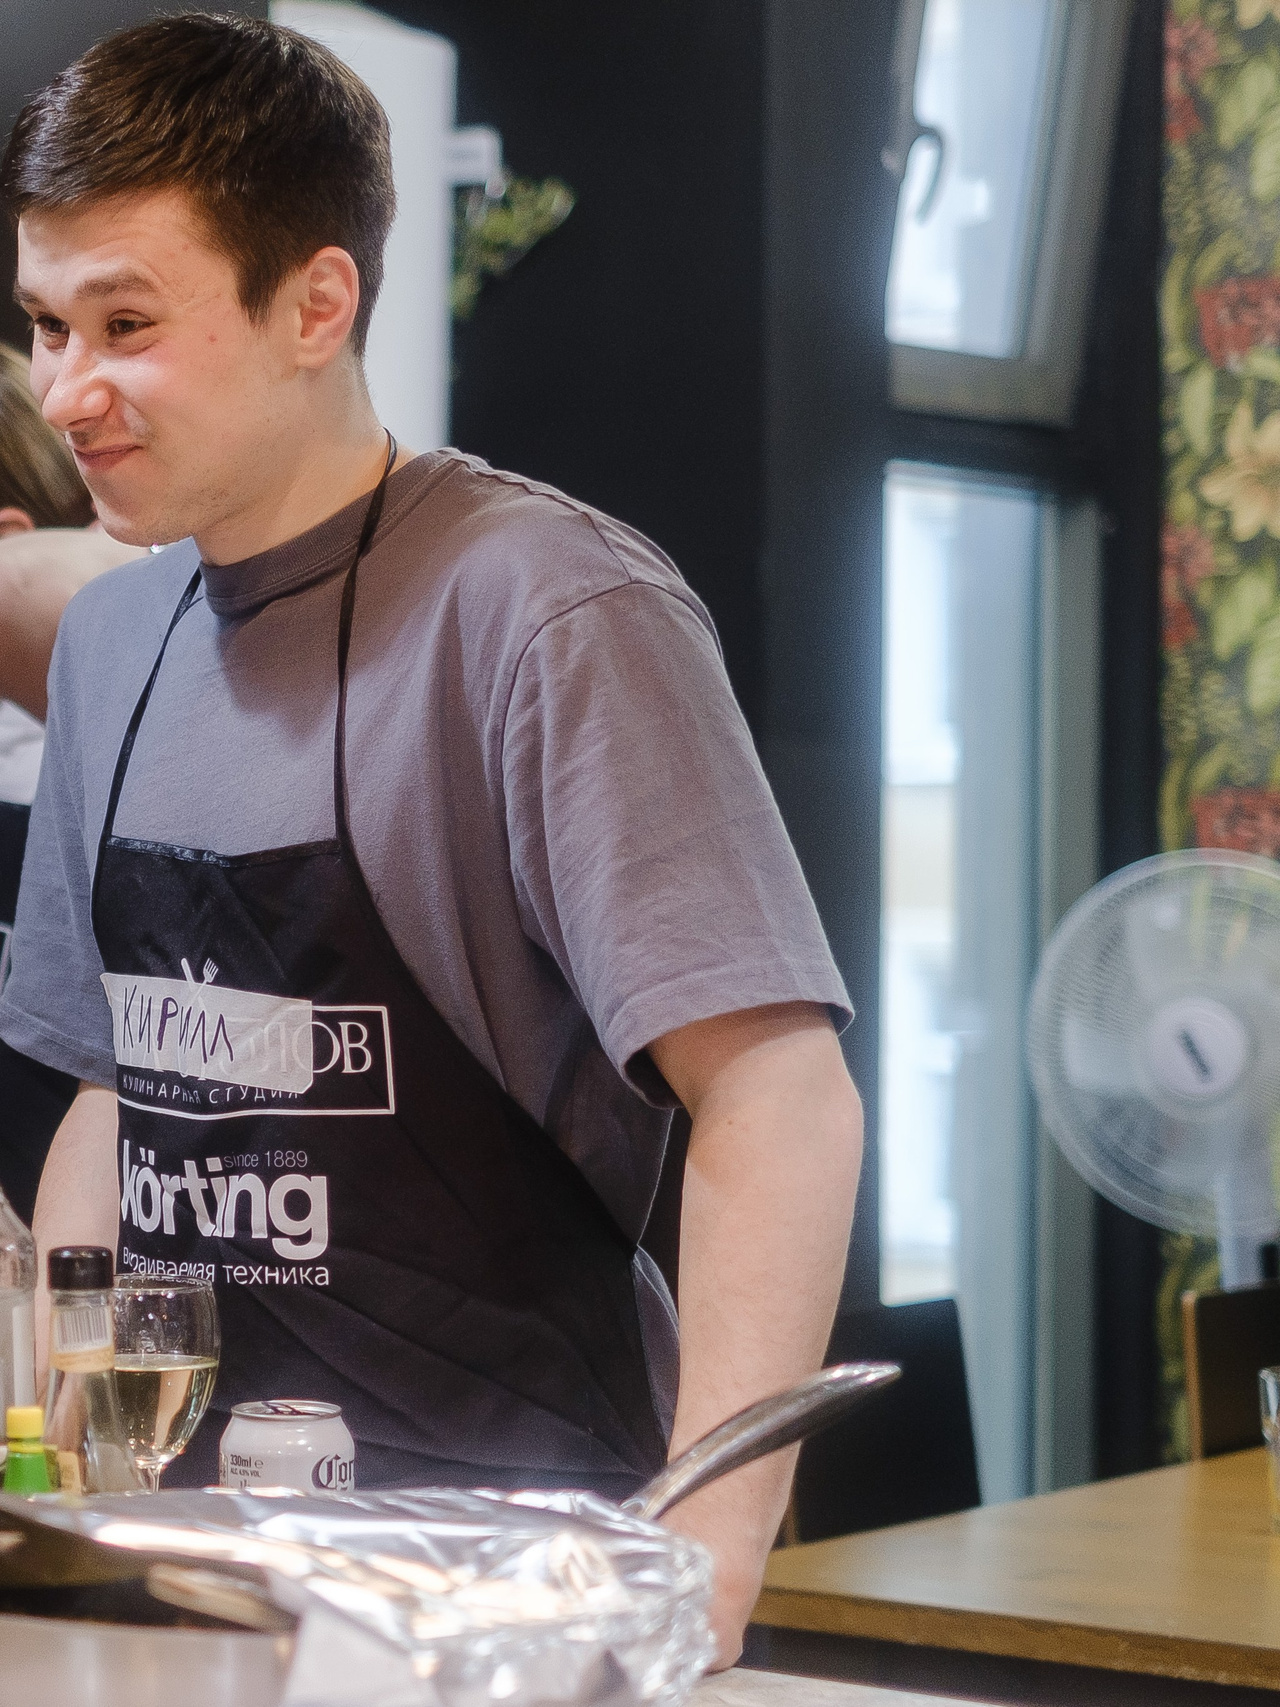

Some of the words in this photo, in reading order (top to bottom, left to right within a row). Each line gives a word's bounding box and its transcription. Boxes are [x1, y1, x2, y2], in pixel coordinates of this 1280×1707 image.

[122, 985, 234, 1064] КИРИЛЛ
[224, 1152, 259, 1168] since
[265, 1150, 308, 1168] 1889
[120, 1139, 329, 1260] körting
[222, 1264, 329, 1286] техника
[230, 1454, 252, 1468] 330ml
